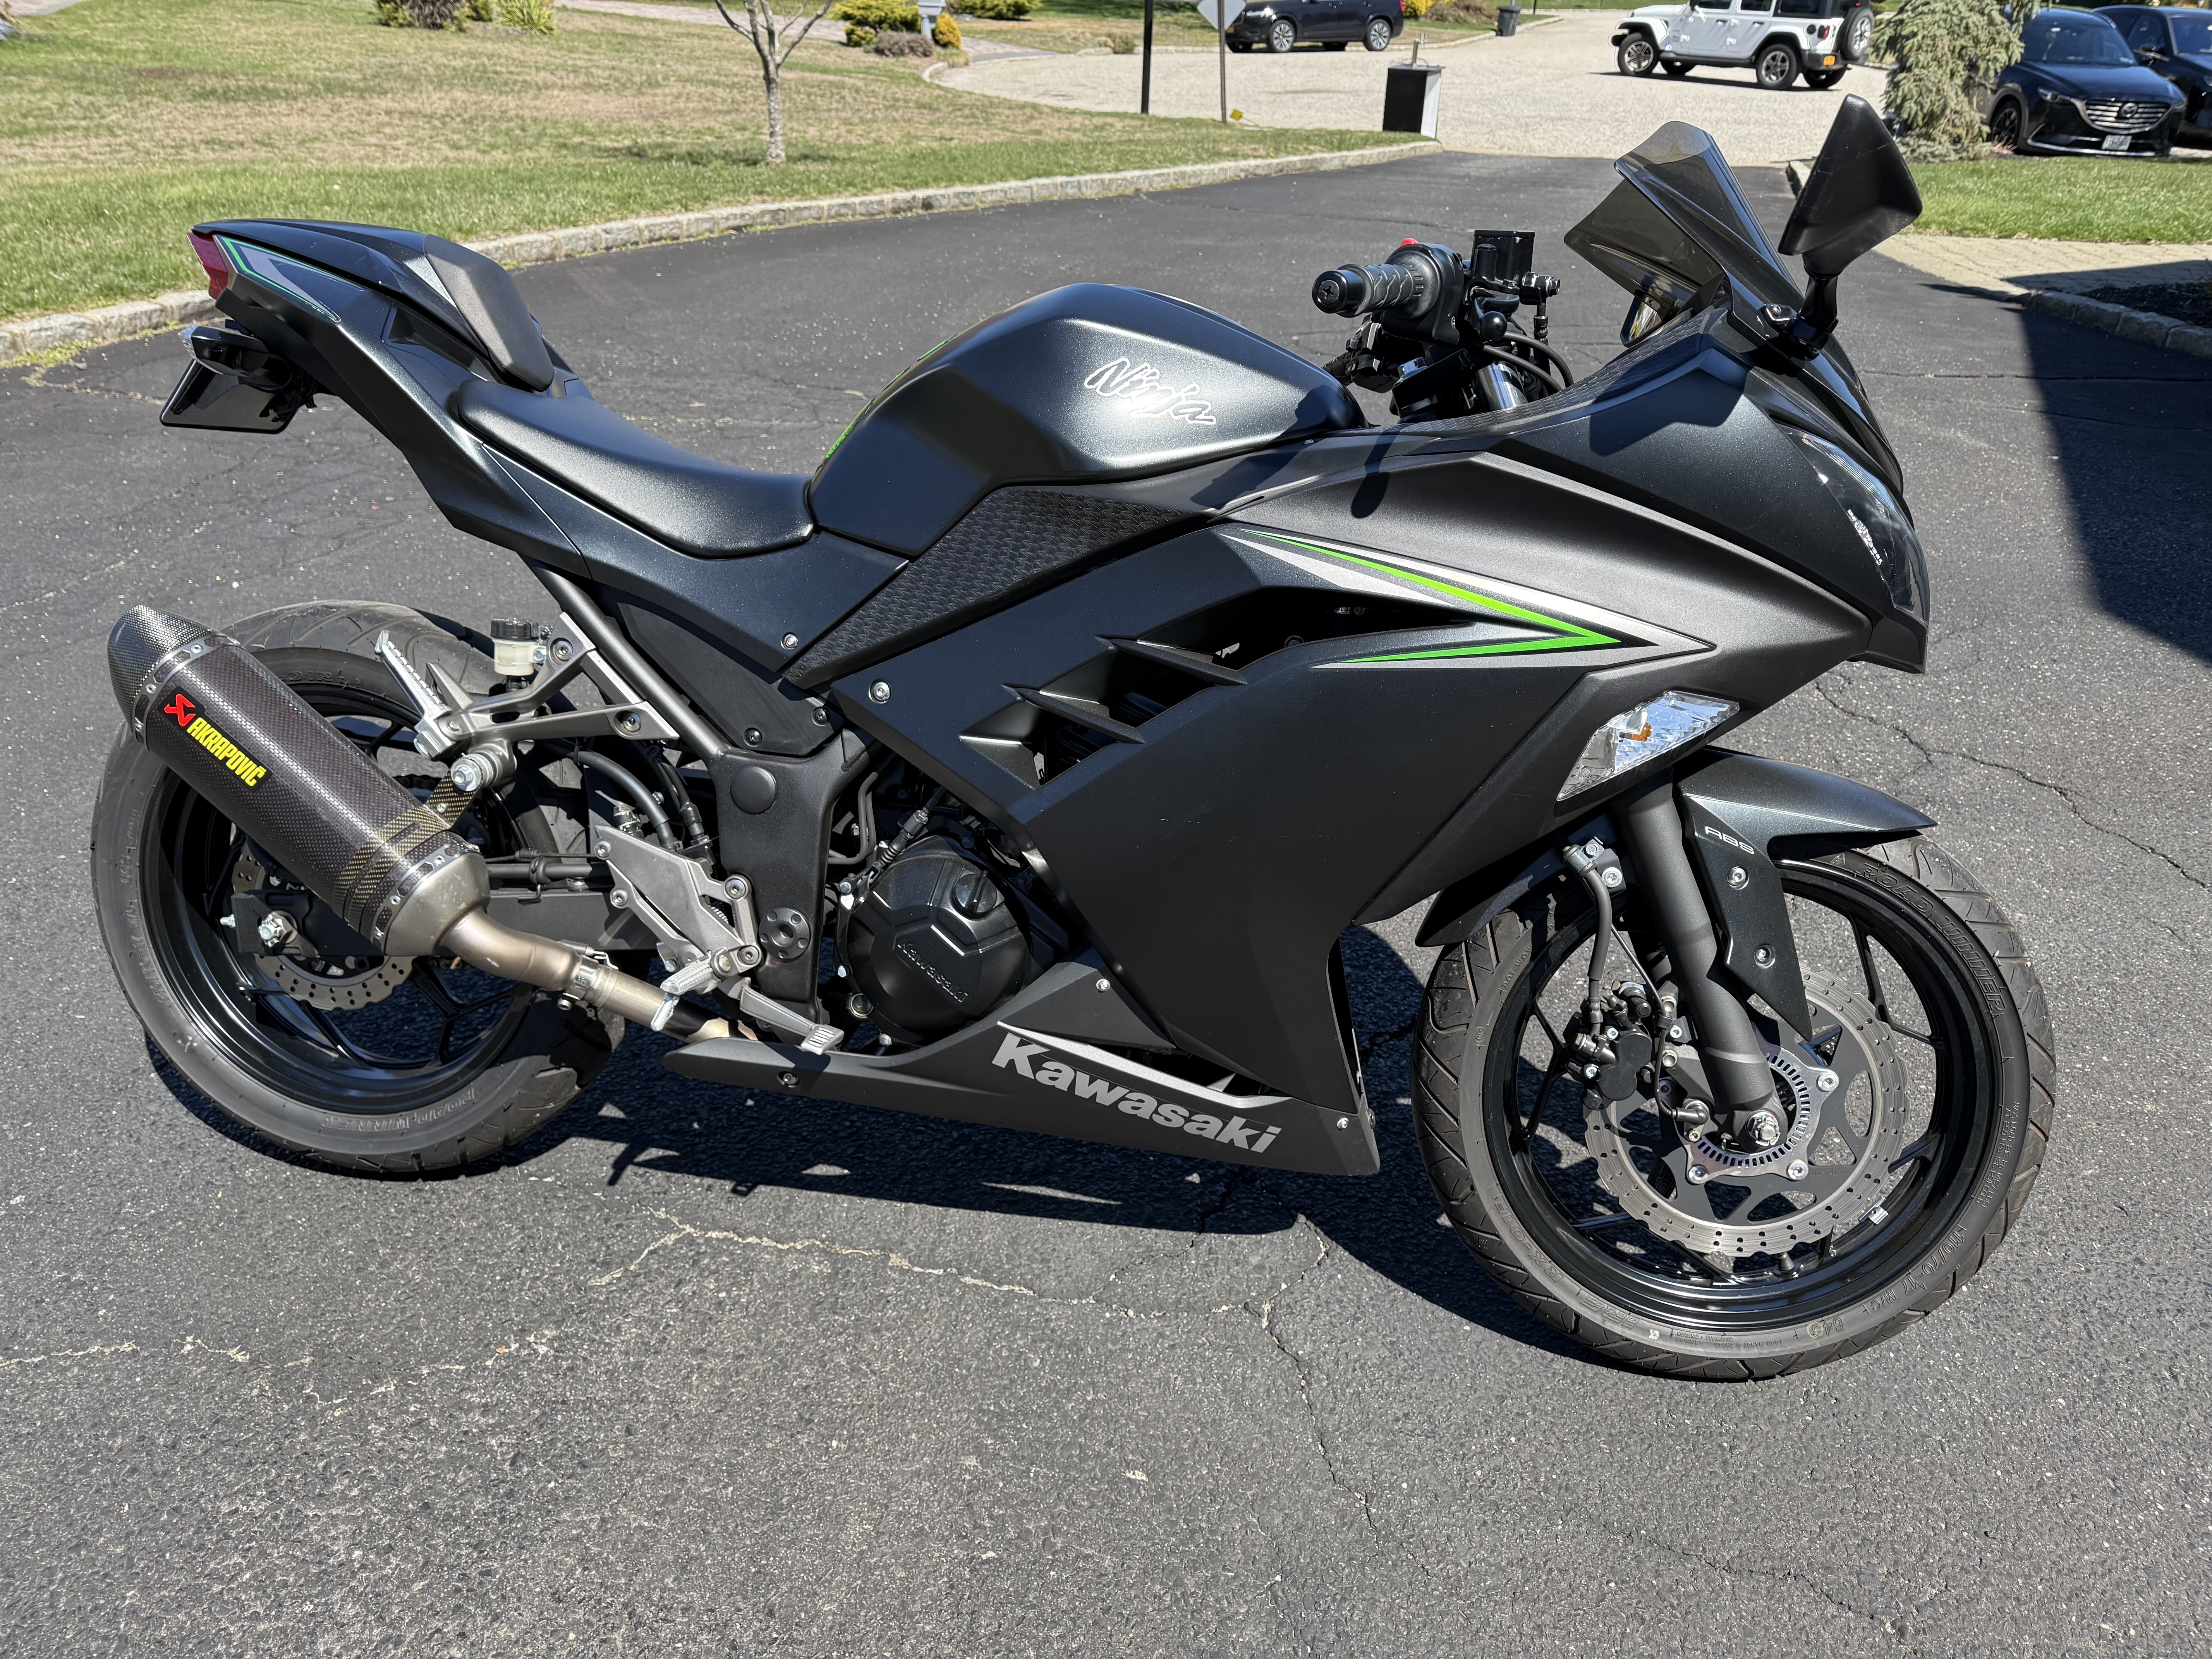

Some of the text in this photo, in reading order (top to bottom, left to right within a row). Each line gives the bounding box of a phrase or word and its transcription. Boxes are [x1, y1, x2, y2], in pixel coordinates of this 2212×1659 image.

[1084, 357, 1216, 425] Ninja
[1705, 826, 1755, 854] ABS
[897, 936, 969, 1003] Kawasaki
[1858, 864, 2005, 1014] ROAD WINNER
[992, 1032, 1283, 1153] Kawasaki
[1494, 1202, 1564, 1283] RX-01F
[1869, 1230, 1964, 1310] 110/70-17 M/C
[1812, 1317, 1842, 1338] 54S
